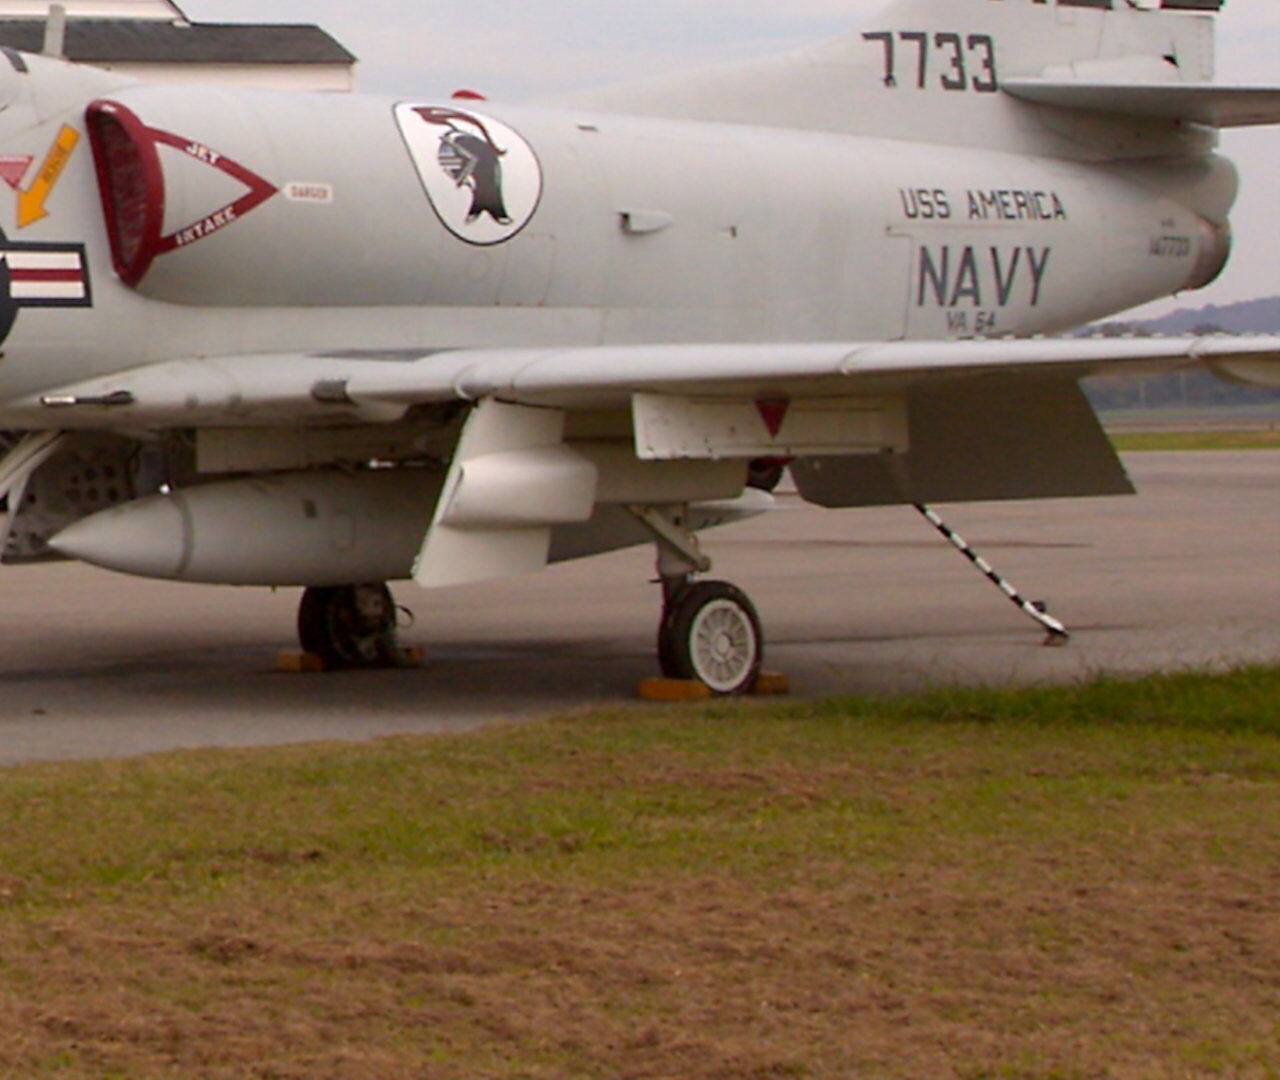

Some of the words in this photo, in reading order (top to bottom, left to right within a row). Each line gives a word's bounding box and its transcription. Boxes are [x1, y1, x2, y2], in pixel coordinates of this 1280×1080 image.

[860, 31, 998, 93] 7733
[185, 142, 220, 165] JET
[899, 188, 951, 219] USS
[966, 190, 1067, 220] AMERICA
[175, 206, 236, 246] INTAKE
[917, 245, 1051, 307] NAVY
